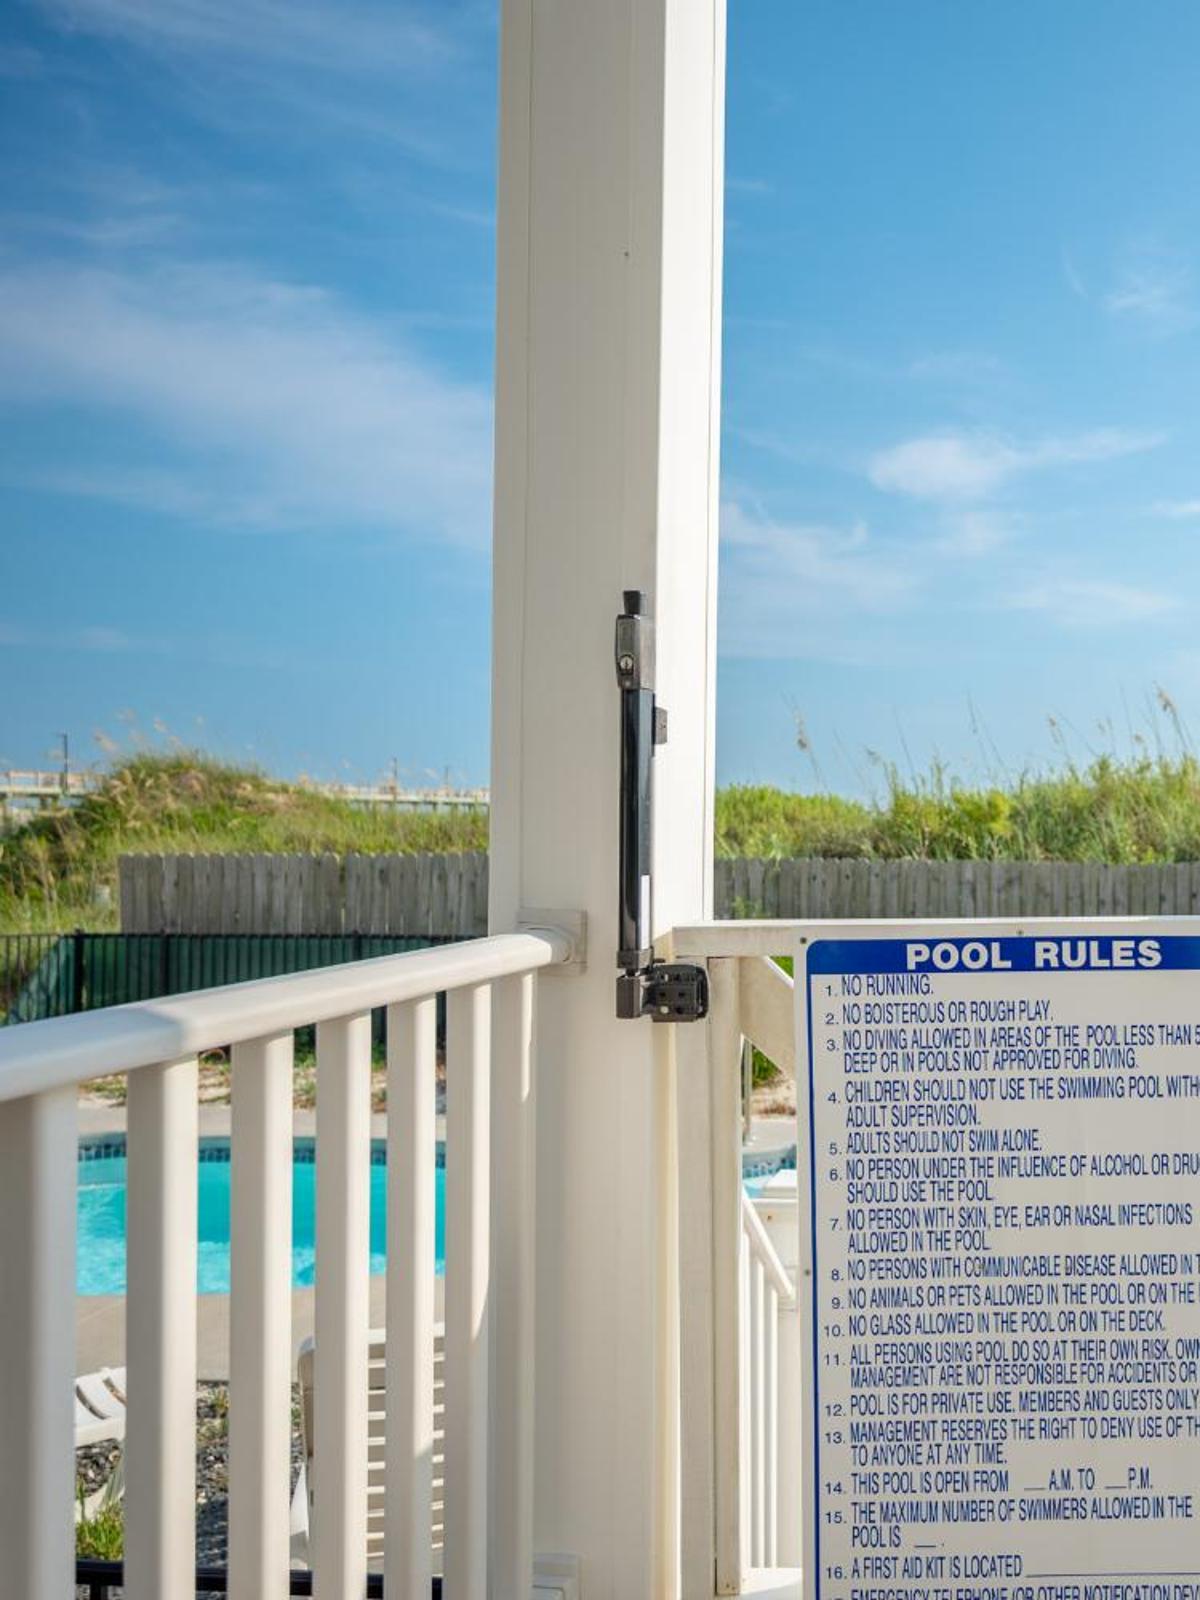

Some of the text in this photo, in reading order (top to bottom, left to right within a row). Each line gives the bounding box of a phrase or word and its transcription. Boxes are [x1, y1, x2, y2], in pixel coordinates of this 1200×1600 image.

[906, 940, 1162, 970] POOL RULES
[841, 975, 934, 996] NO RUNNING.
[843, 999, 1053, 1025] NO BOISTEROUS OR ROUGH PLAY.
[843, 1029, 861, 1050] NO
[865, 1028, 908, 1050] DIVING
[910, 1027, 971, 1049] ALLOWED
[990, 1026, 1033, 1048] AREAS
[1035, 1026, 1052, 1047] OF
[1053, 1026, 1080, 1047] THE
[1086, 1025, 1120, 1046] POOL
[1122, 1025, 1155, 1046] LESS
[1158, 1024, 1191, 1045] THAN
[844, 1048, 1090, 1073] DEEP OR POOLS NOT APPROVED FOR
[845, 1080, 909, 1102] CHILDREN
[913, 1079, 966, 1101] SHOULD
[969, 1078, 996, 1100] NOT
[1000, 1078, 1025, 1099] USE
[1028, 1077, 1055, 1099] THE
[1057, 1076, 1125, 1099] SWIMMING
[1128, 1076, 1164, 1097] POOL
[846, 1103, 981, 1128] ADULT SUPERVISION.
[846, 1129, 1042, 1154] ADULTS SHOULD NOT SWIM ALONE.
[846, 1159, 865, 1180] NO
[868, 1158, 919, 1179] PERSON
[923, 1157, 967, 1178] UNDER
[969, 1157, 994, 1178] THE
[998, 1155, 1067, 1177] INFLUENCE
[1069, 1155, 1087, 1176] OF
[1090, 1154, 1149, 1176] ALCOHOL
[1151, 1154, 1170, 1175] OR
[847, 1180, 954, 1203] SHOULD USE THE
[846, 1203, 1192, 1231] NO PERSON WITH SKIN, EAR OR NASAL INFECTIONS
[848, 1230, 952, 1253] ALLOWED THE
[848, 1259, 866, 1280] NO
[868, 1258, 928, 1280] PERSONS
[930, 1257, 963, 1279] WITH
[964, 1256, 1061, 1278] COMMUNICABLE
[1063, 1255, 1116, 1277] DISEASE
[1119, 1254, 1178, 1276] ALLOWED
[847, 1287, 867, 1308] NO
[870, 1286, 924, 1308] ANIMALS
[926, 1286, 946, 1307] OR
[949, 1285, 982, 1307] PETS
[984, 1284, 1044, 1306] ALLOWED
[1062, 1284, 1087, 1305] THE
[1091, 1283, 1125, 1305] POOL
[1127, 1283, 1146, 1304] OR
[1148, 1282, 1167, 1304] ON
[1170, 1282, 1195, 1304] THE
[849, 1310, 1125, 1336] NO GLASS ALLOWED THE POOL OR ON THE
[849, 1343, 872, 1364] ALL
[875, 1342, 932, 1364] PERSONS
[935, 1342, 973, 1363] USING
[976, 1341, 1010, 1362] POOL
[1011, 1341, 1029, 1362] DO
[1032, 1341, 1050, 1361] SO
[1070, 1340, 1107, 1361] THEIR
[1110, 1339, 1138, 1360] OWN
[851, 1365, 936, 1387] MANAGEMENT
[939, 1365, 964, 1386] ARE
[966, 1364, 992, 1385] NOT
[994, 1363, 1077, 1385] RESPONSIBLE
[1080, 1363, 1105, 1384] FOR
[1107, 1362, 1176, 1383] ACCIDENTS
[1179, 1361, 1197, 1382] OR
[850, 1393, 885, 1415] POOL
[900, 1393, 928, 1414] FOR
[931, 1392, 984, 1413] PRIVATE
[1019, 1390, 1081, 1412] MEMBERS
[1083, 1390, 1110, 1411] AND
[1112, 1389, 1164, 1411] GUESTS
[850, 1420, 938, 1443] MANAGEMENT
[941, 1419, 1008, 1441] RESERVES
[1010, 1419, 1036, 1440] THE
[1038, 1418, 1077, 1439] RIGHT
[1080, 1418, 1098, 1439] TO
[1101, 1417, 1135, 1438] DENY
[1137, 1417, 1162, 1438] USE
[1166, 1416, 1184, 1437] OF
[850, 1442, 1007, 1465] TO ANYONE AT ANY TIME.
[850, 1469, 1095, 1494] THIS POOL OPEN FROM TO
[850, 1497, 1193, 1523] THE MAXIMUM NUMBER OF SWIMMERS ALLOWED THE
[852, 1526, 887, 1548] POOL
[863, 1555, 1022, 1578] FIRST AID KIT LOCATED
